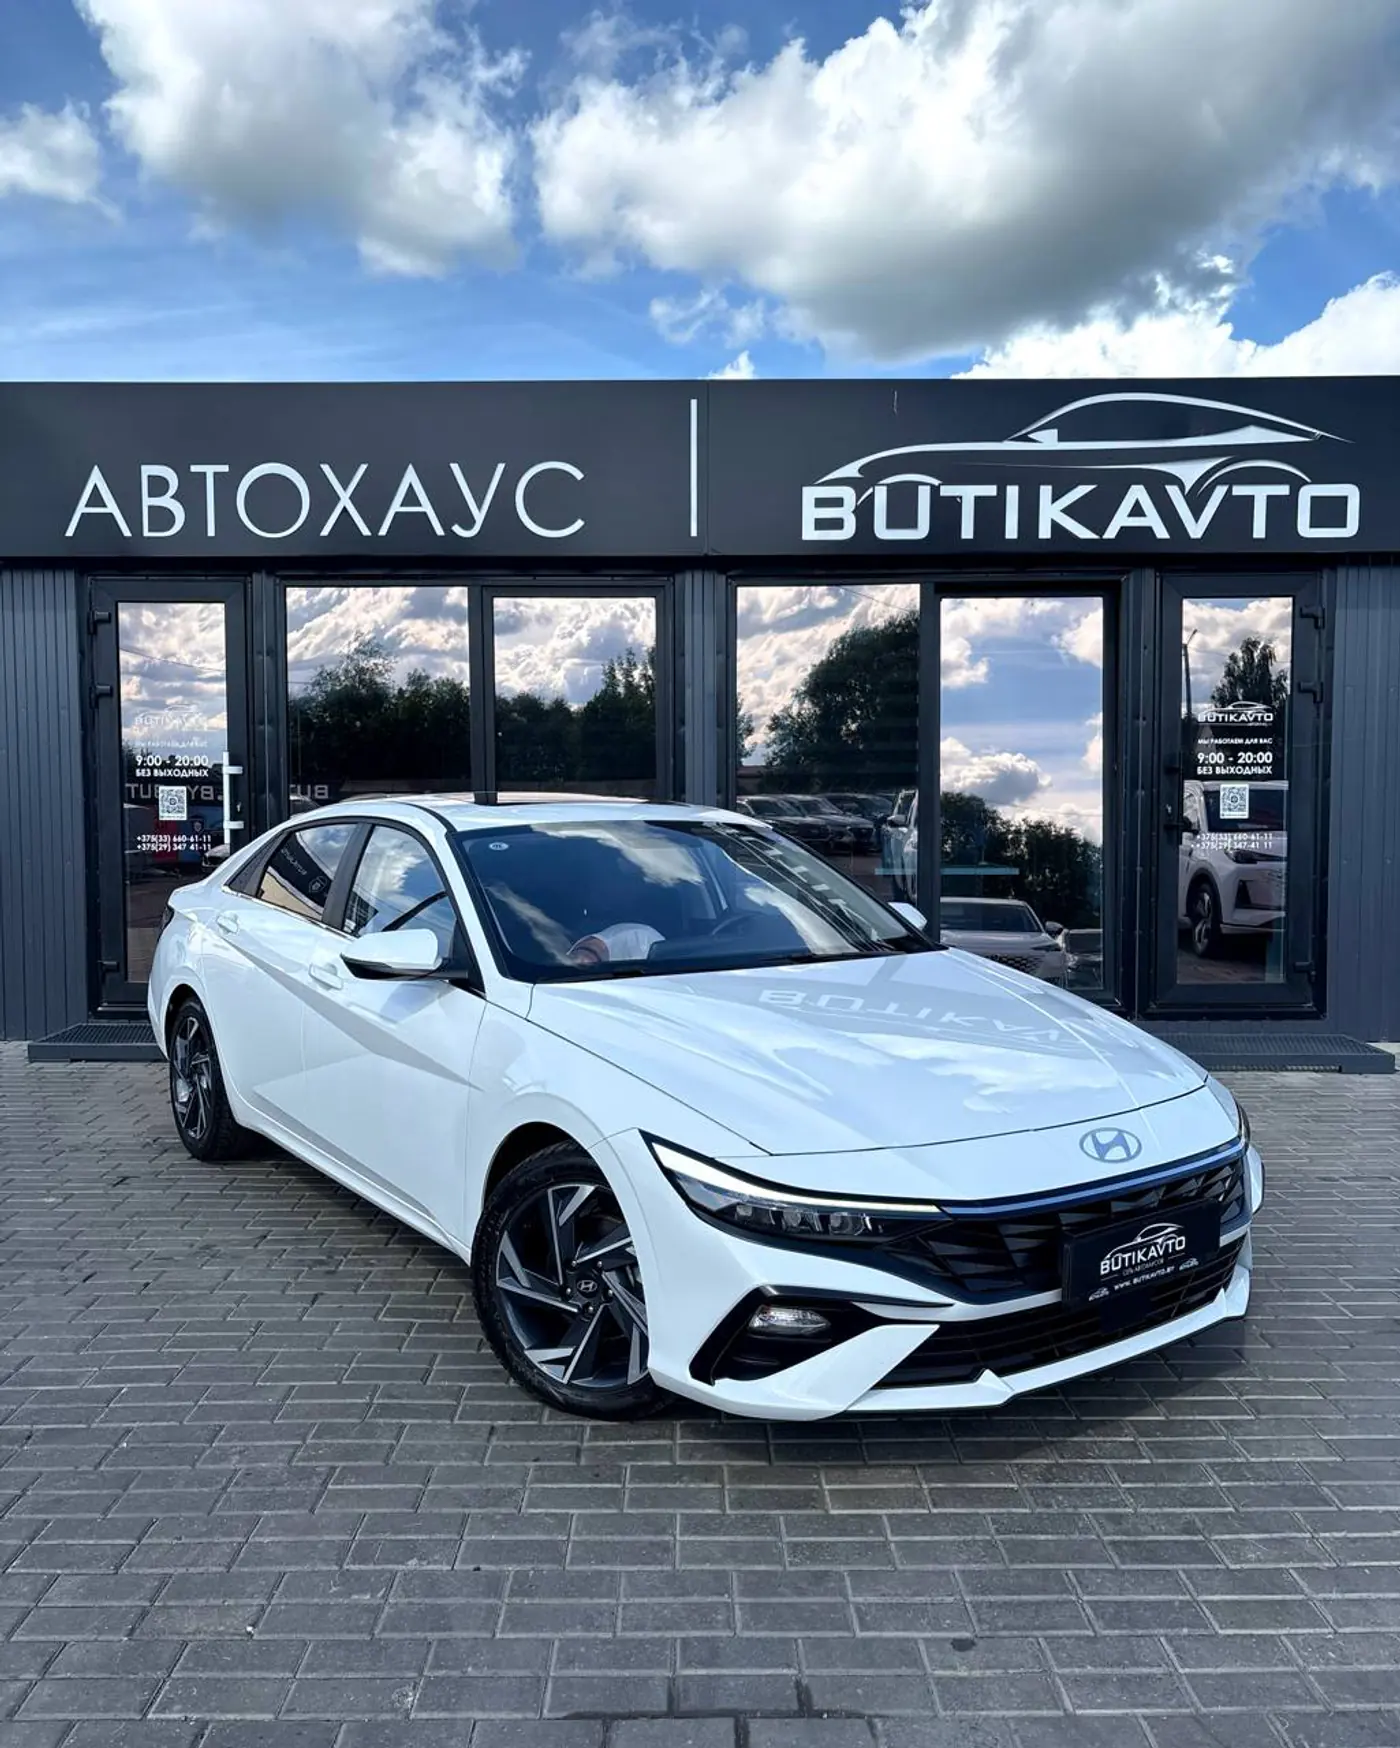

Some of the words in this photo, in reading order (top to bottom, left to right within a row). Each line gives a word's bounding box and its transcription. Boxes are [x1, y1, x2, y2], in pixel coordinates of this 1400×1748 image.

[65, 461, 586, 539] АВТОХАУС
[802, 484, 1361, 541] BUTIKAVTO
[1197, 712, 1274, 722] BUTIKAVTO
[136, 755, 162, 767] 9:00
[175, 755, 209, 767] 20:00
[1197, 752, 1225, 764] 9:00
[1237, 751, 1273, 764] 20:00
[135, 768, 152, 777] БЕЗ
[153, 769, 209, 778] ВЫХОДНЫХ
[1197, 766, 1213, 775] БЕЗ
[1215, 766, 1273, 775] ВЫХОДНЫХ
[172, 843, 211, 851] 34741-11
[1100, 1236, 1186, 1275] BUTIKAVTO
